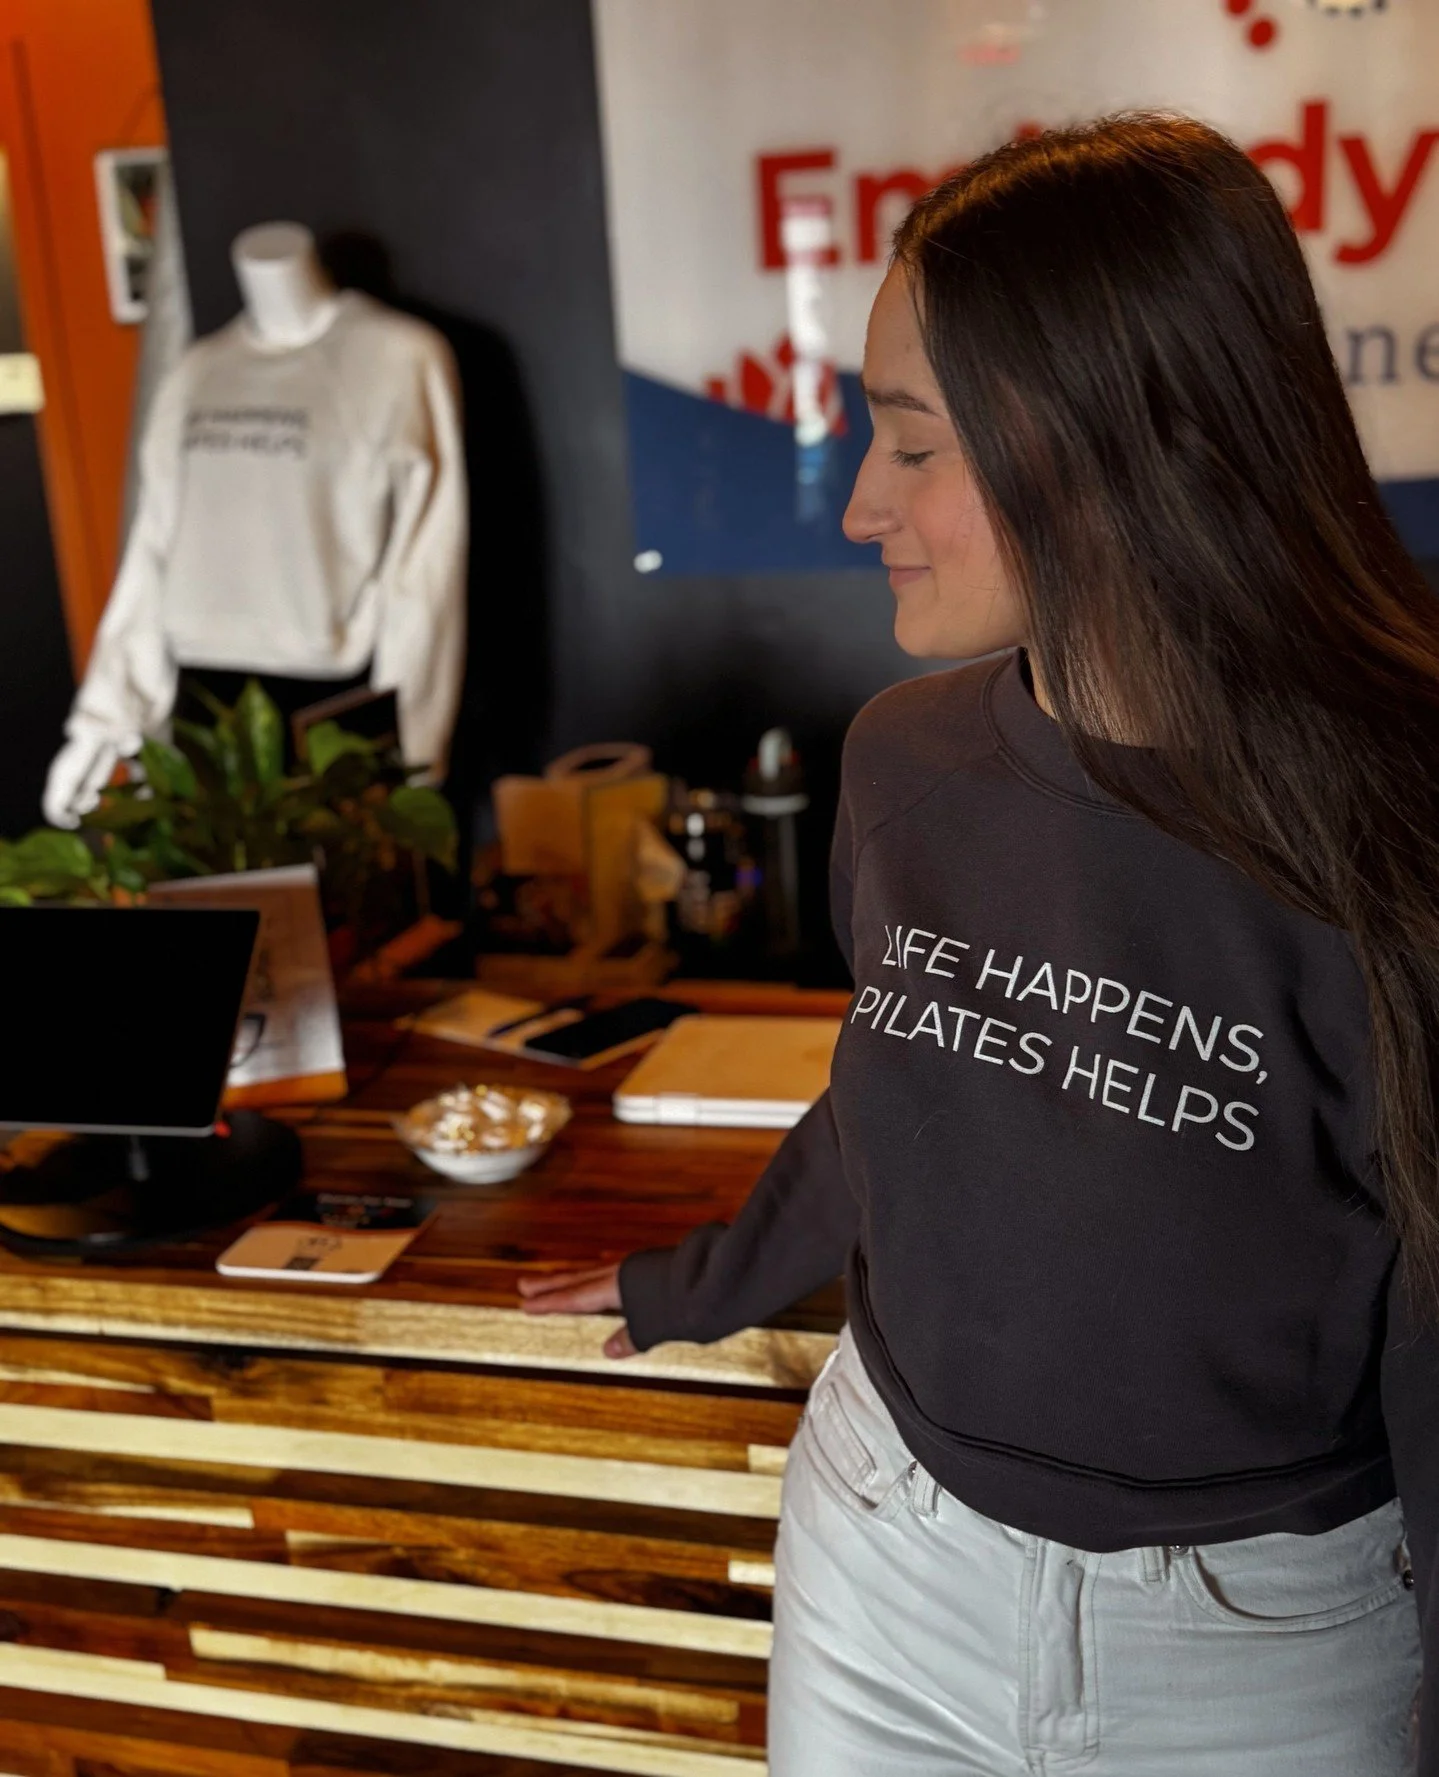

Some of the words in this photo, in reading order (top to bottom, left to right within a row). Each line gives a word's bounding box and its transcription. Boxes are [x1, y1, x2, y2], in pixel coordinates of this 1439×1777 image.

[850, 985, 1053, 1076] PILATES
[1061, 1044, 1260, 1152] HELPS
[881, 924, 970, 979] LIFE
[975, 948, 1269, 1086] HAPPENS,
